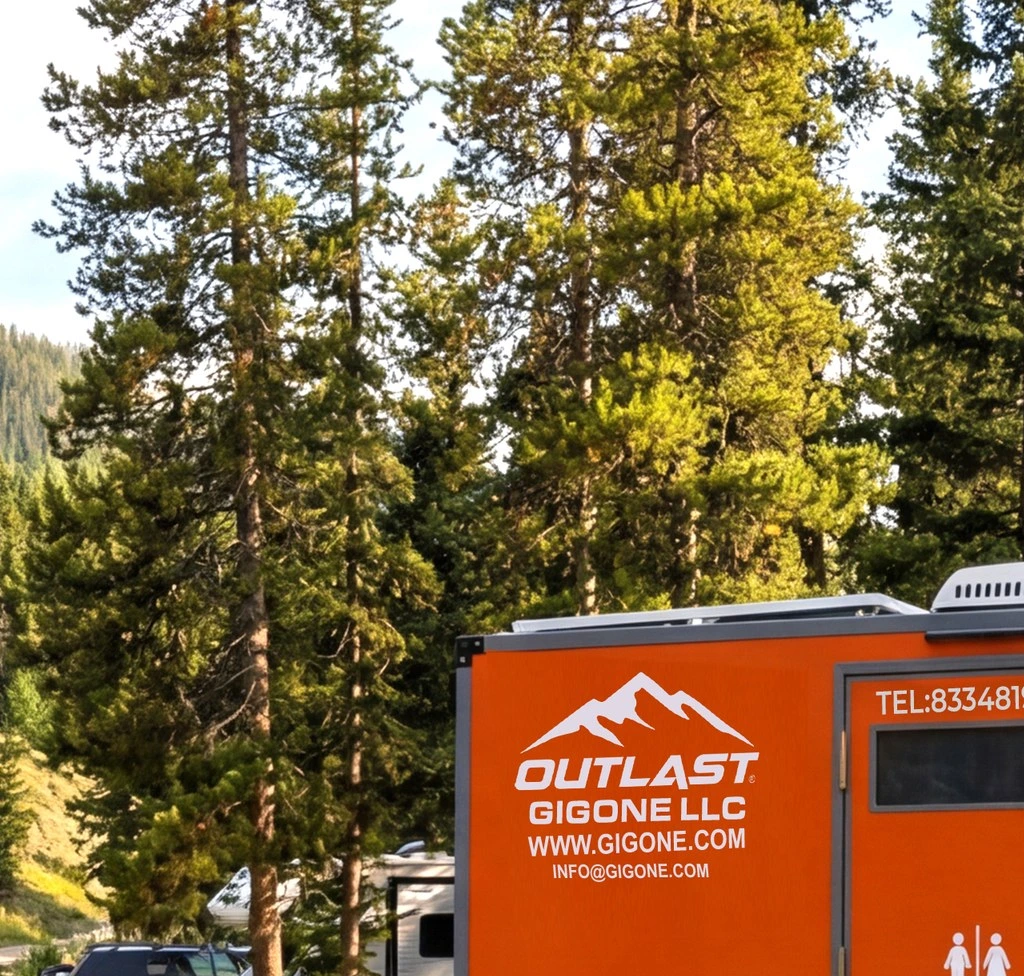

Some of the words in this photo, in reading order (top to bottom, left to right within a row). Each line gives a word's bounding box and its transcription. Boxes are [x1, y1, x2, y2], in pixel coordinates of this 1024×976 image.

[515, 752, 759, 790] OUTLAST
[530, 798, 671, 824] GIGONE
[681, 797, 745, 820] LLC
[528, 828, 745, 856] WWW.GIGONE.COM
[553, 864, 708, 882] INFO@GIGONE.COM
